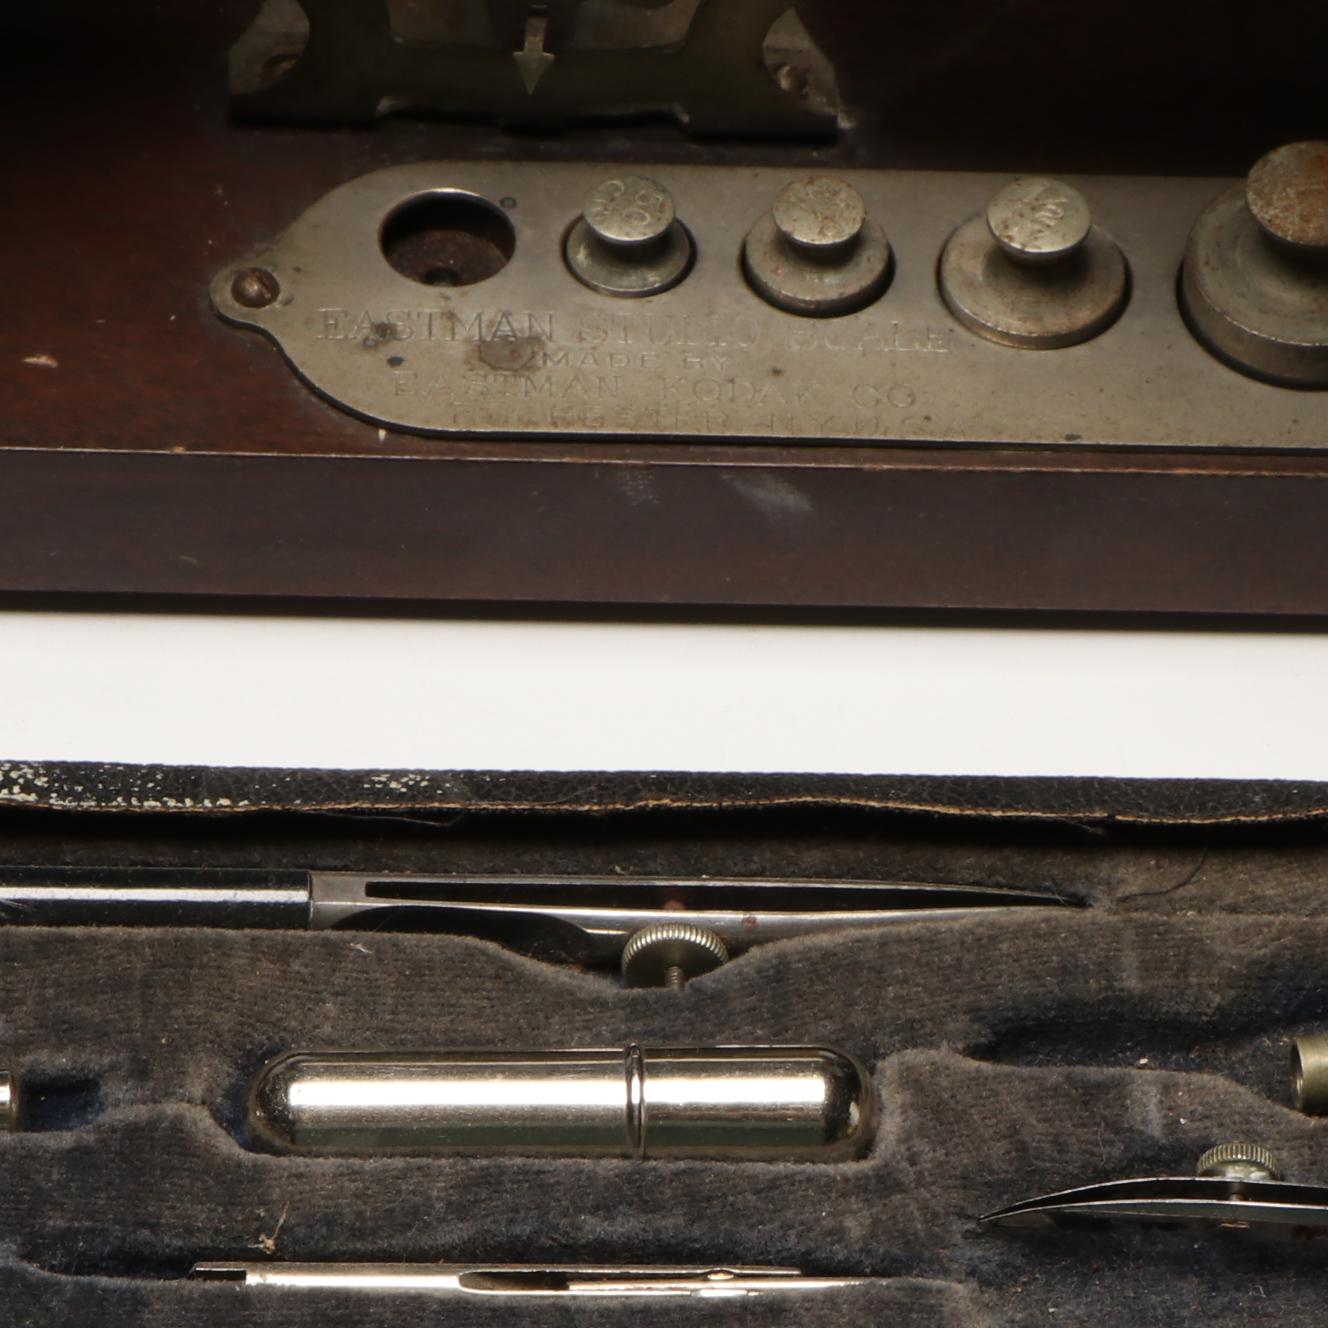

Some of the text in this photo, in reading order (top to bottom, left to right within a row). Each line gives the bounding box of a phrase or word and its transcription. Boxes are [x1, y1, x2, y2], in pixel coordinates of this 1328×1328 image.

[315, 308, 555, 342] EASTMAN
[542, 350, 730, 372] MADE BY
[392, 370, 624, 400] EASTMAN
[658, 375, 821, 406] KODAK
